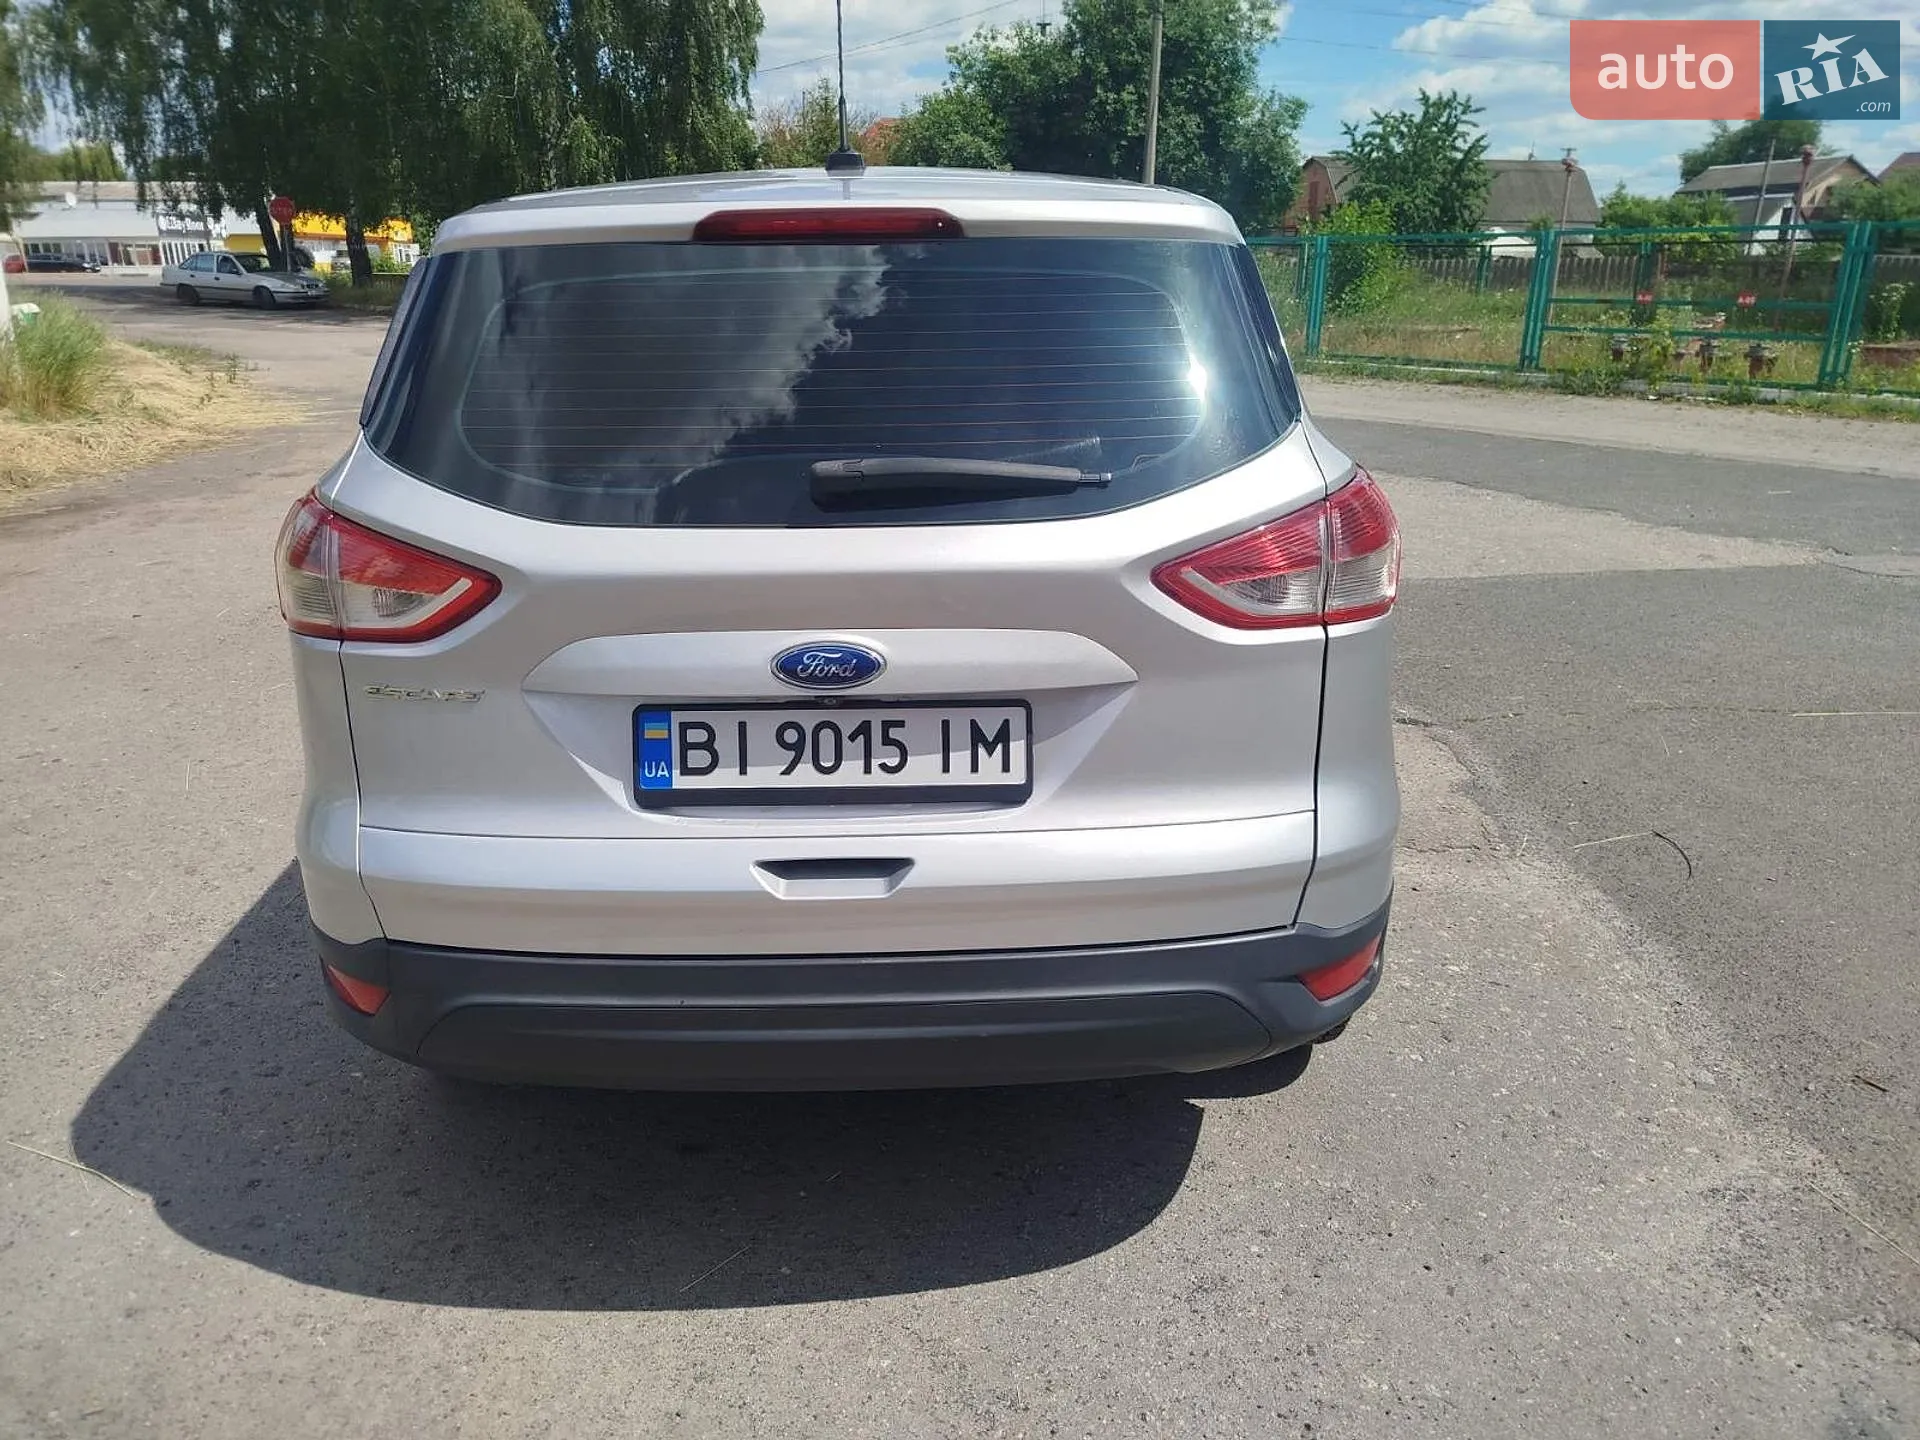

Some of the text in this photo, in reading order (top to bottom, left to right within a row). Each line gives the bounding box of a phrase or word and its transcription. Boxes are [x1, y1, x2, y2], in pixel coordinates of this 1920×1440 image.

[797, 651, 858, 677] Ford
[679, 718, 1011, 776] BI 9015 IM
[644, 760, 670, 778] UA
